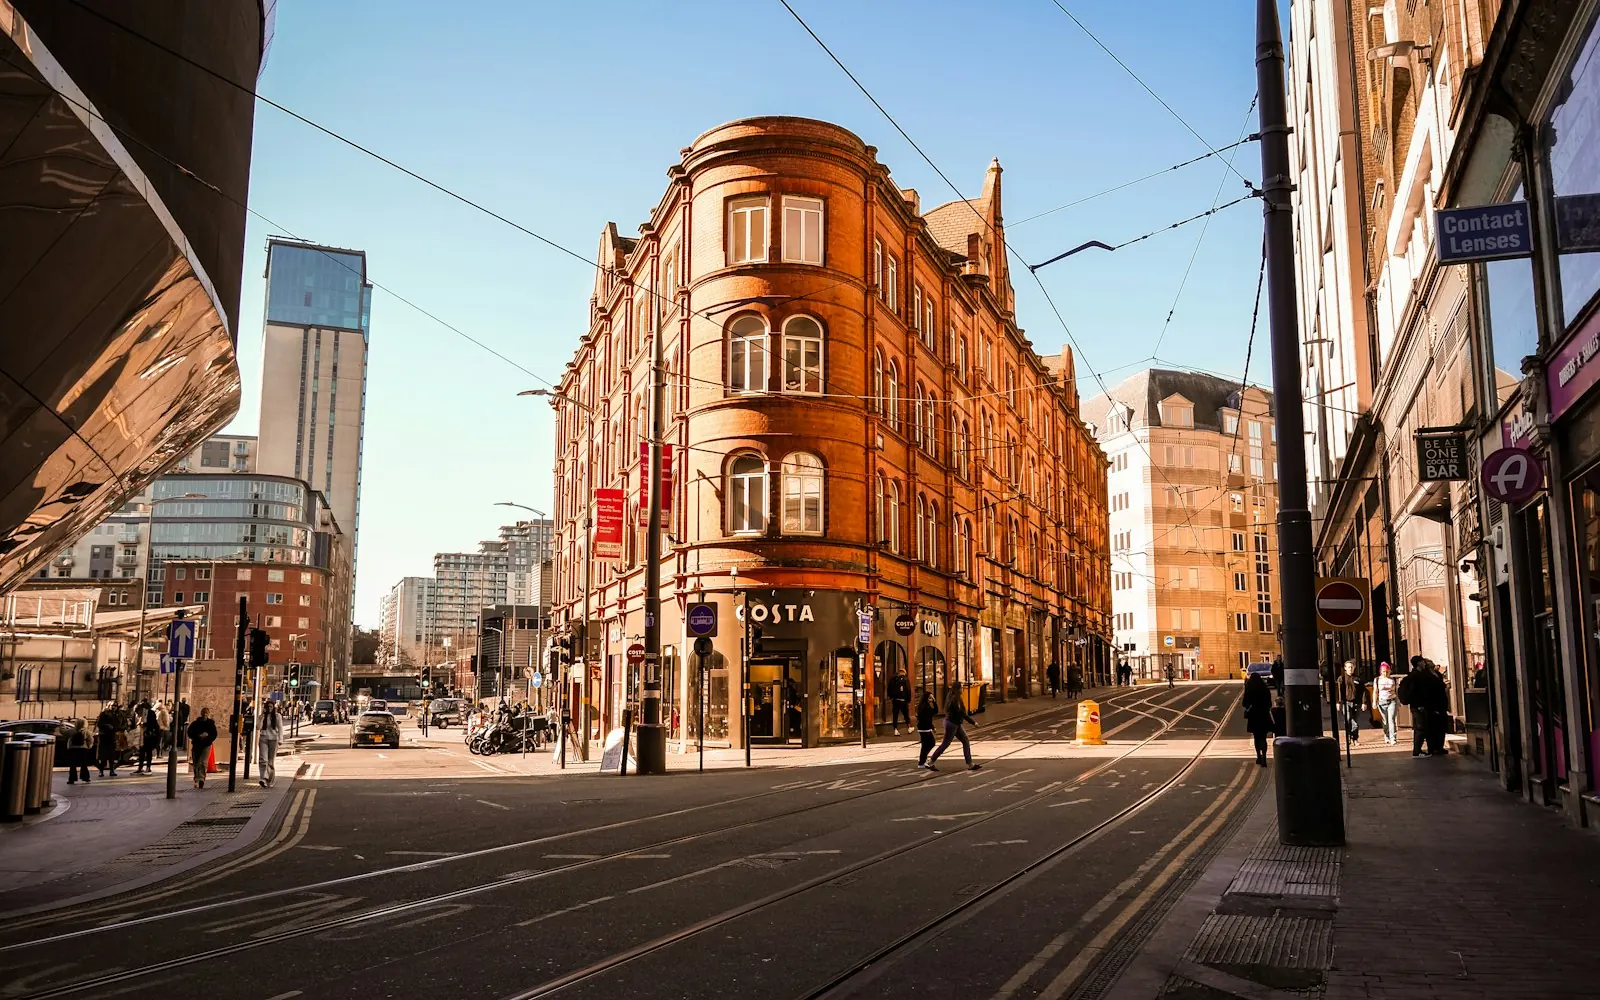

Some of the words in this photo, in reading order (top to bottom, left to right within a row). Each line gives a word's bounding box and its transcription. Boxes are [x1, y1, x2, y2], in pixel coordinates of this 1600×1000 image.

[1443, 209, 1524, 234] Contact
[1450, 233, 1520, 254] Lenses
[1424, 439, 1440, 449] BE
[1444, 438, 1457, 447] AT
[1425, 447, 1459, 460] ONE
[1426, 464, 1460, 479] BAR
[923, 620, 941, 637] COSTA
